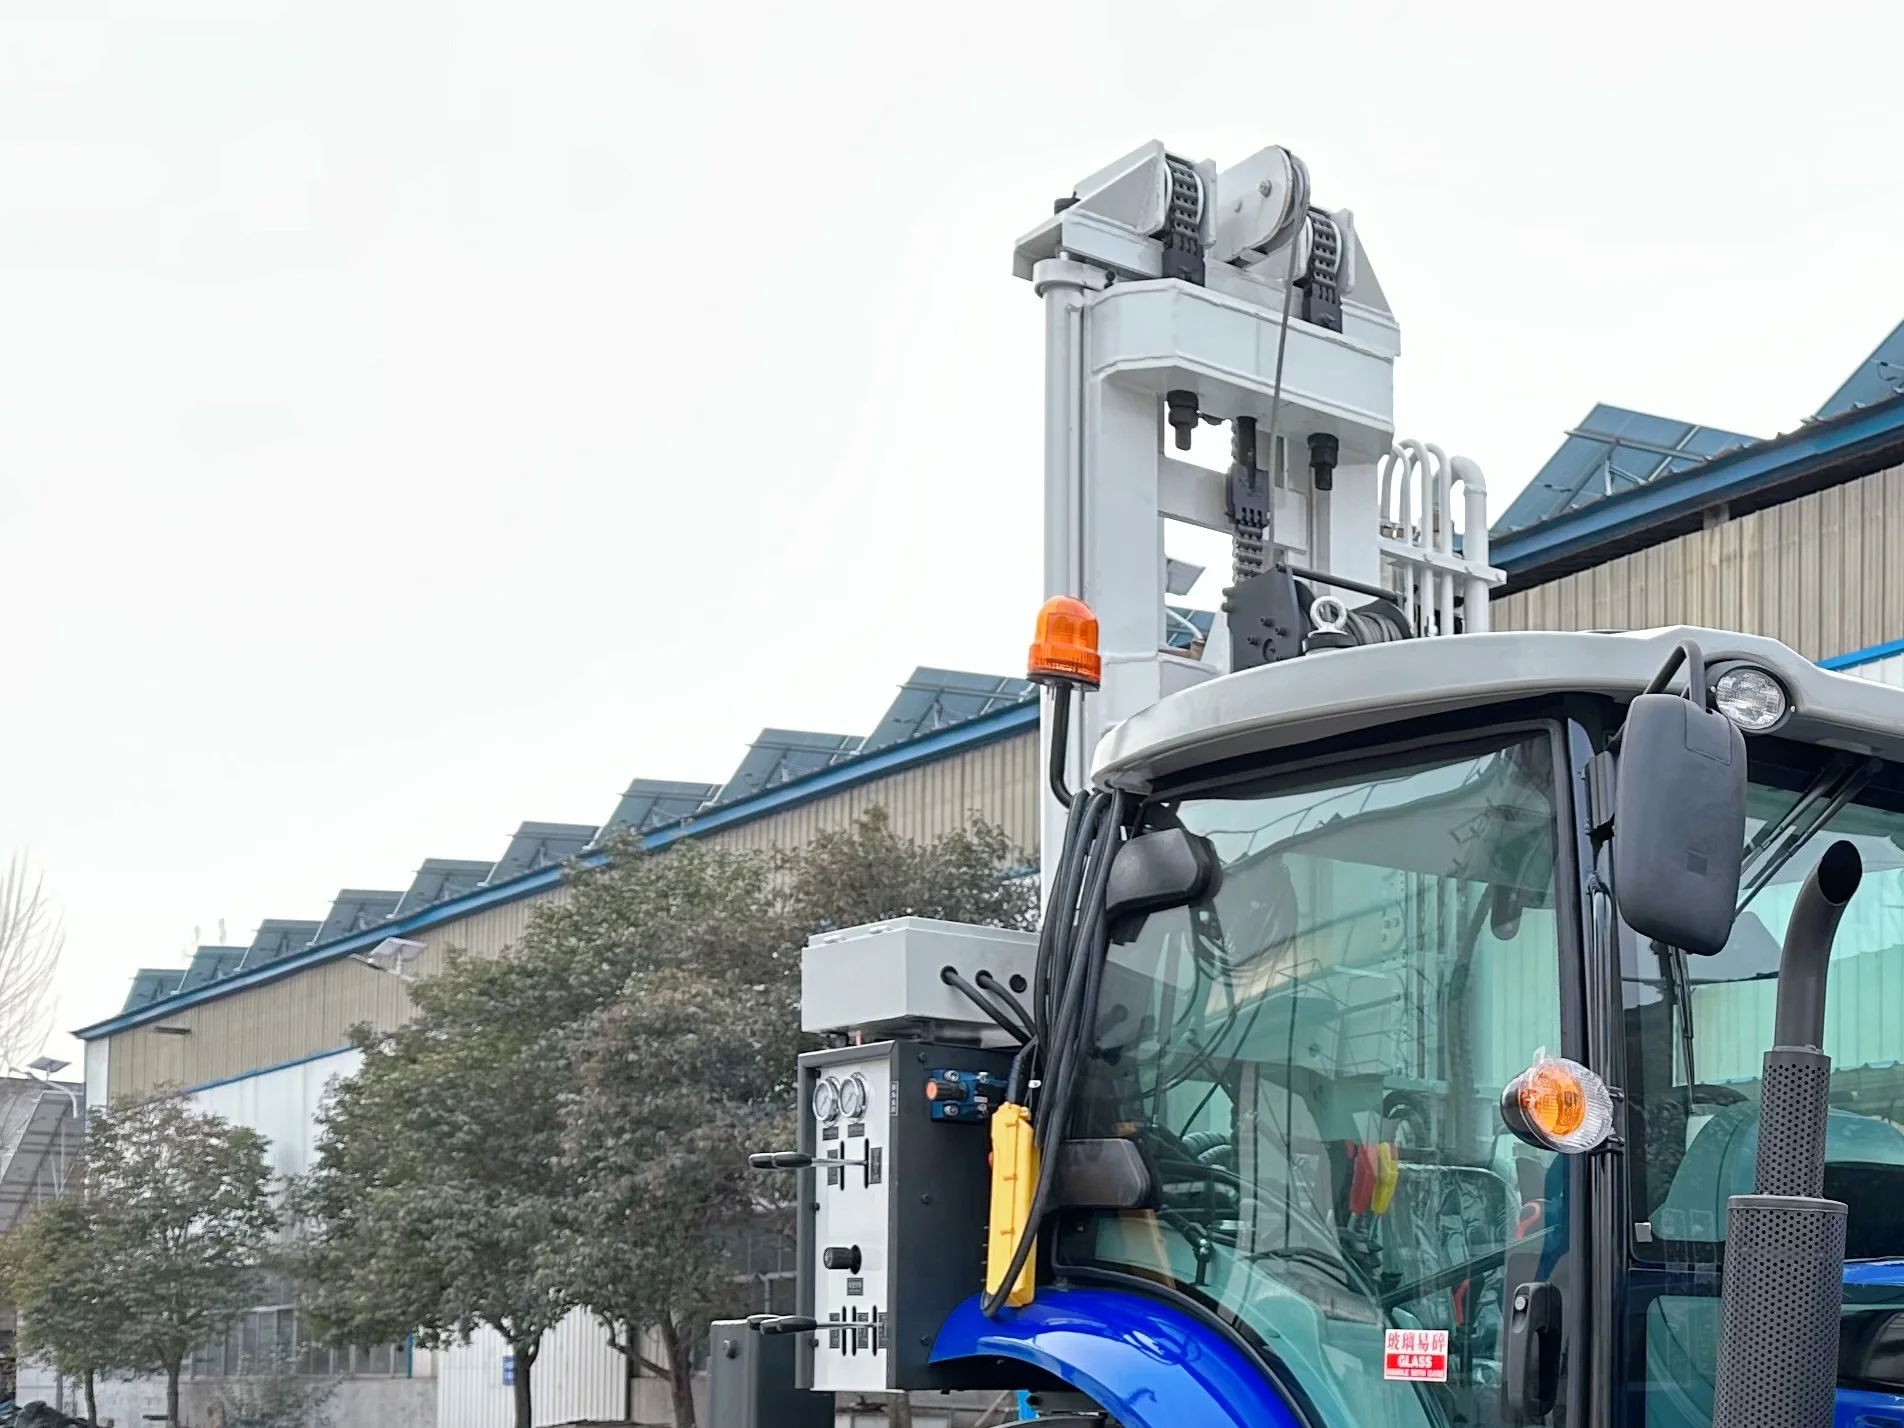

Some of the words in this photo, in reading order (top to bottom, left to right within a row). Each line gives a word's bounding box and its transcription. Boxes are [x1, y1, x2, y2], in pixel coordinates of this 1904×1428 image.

[1387, 1332, 1446, 1352] 玻璃易碎
[1397, 1355, 1433, 1368] GLASS
